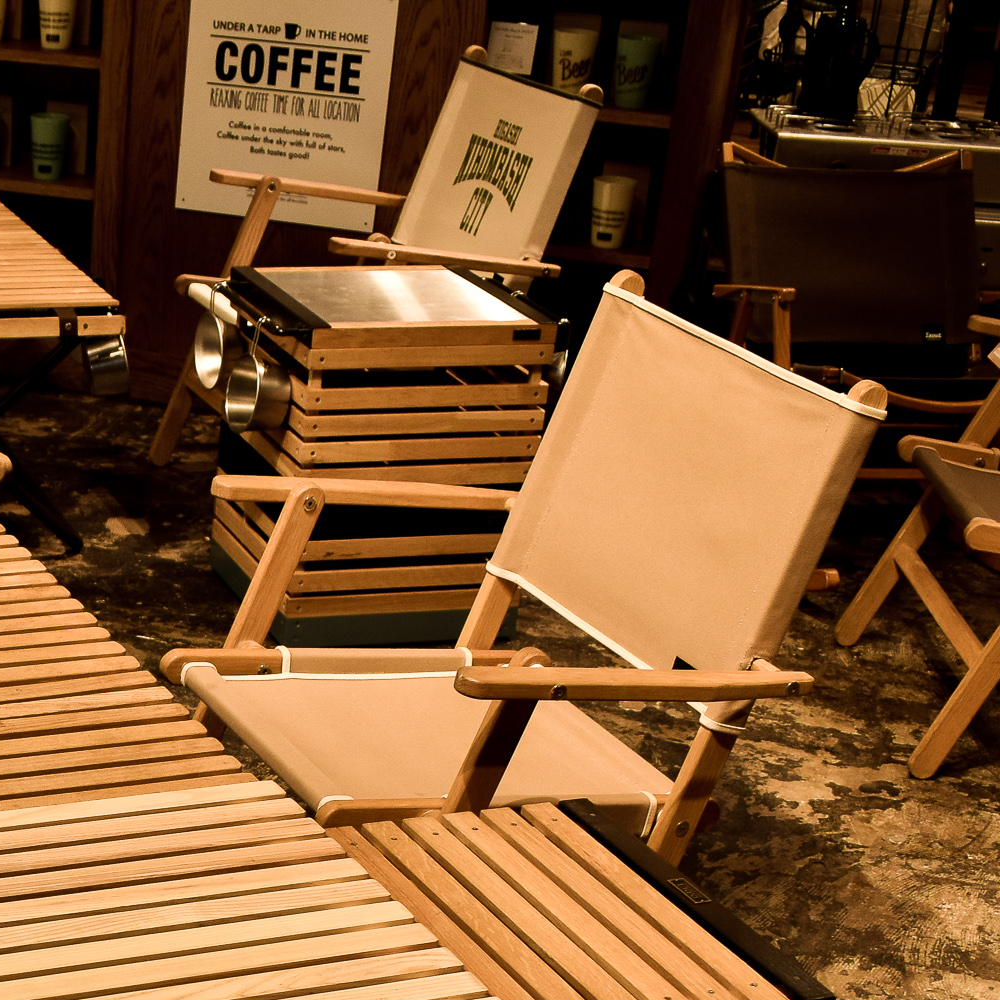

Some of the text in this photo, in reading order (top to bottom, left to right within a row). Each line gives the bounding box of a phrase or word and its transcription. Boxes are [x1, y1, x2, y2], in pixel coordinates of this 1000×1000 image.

[213, 20, 369, 44] UNDER A TARP IN THE HOME
[215, 40, 363, 95] COFFEE
[559, 57, 591, 81] Beer
[245, 91, 269, 112] COFFEE
[273, 94, 289, 115] TIME
[291, 95, 305, 117] FOR
[308, 98, 320, 119] ALL
[323, 99, 361, 122] LOCATION
[217, 130, 239, 140] Coffee
[241, 134, 261, 142] under
[263, 135, 274, 144] the
[276, 136, 287, 147] sky
[289, 139, 304, 147] with
[305, 139, 317, 149] full
[318, 142, 327, 150] of
[228, 120, 252, 130] Coffee
[253, 123, 260, 131] in
[269, 125, 310, 137] comfortable
[312, 132, 333, 141] room,
[250, 145, 310, 160] Both tastes good!
[459, 186, 494, 237] CITY
